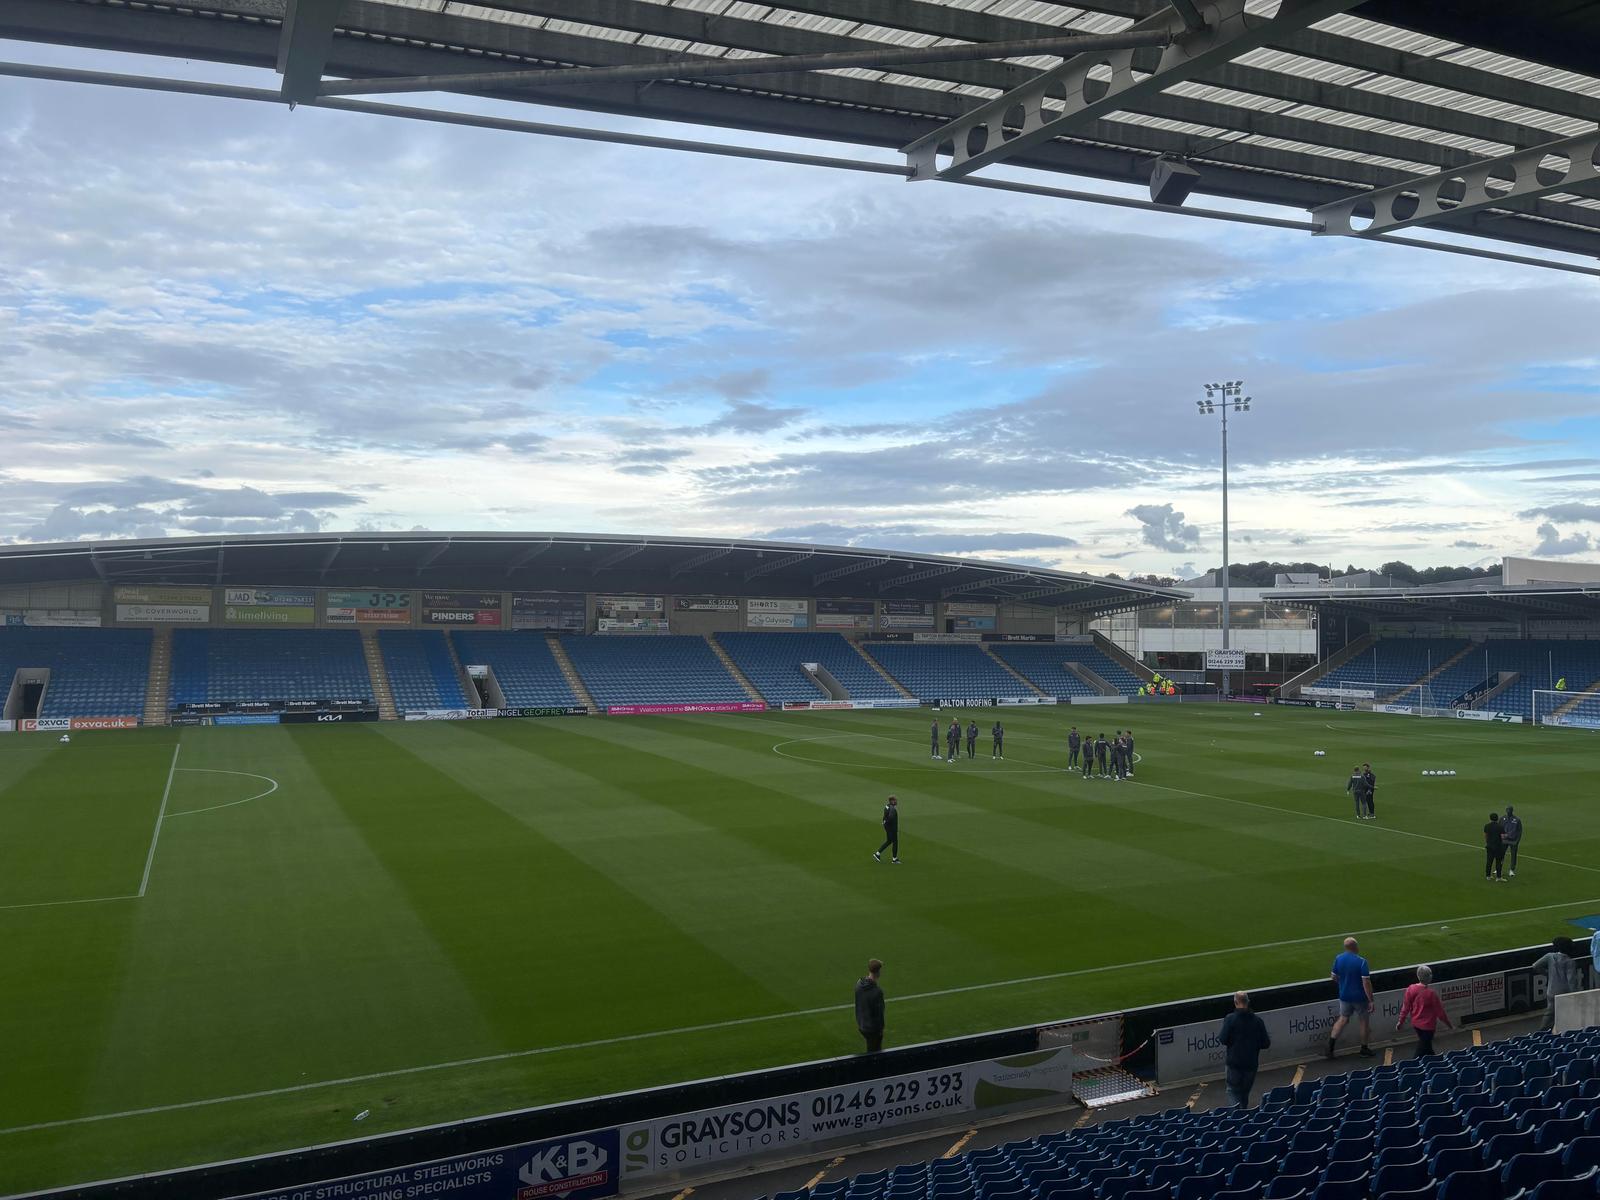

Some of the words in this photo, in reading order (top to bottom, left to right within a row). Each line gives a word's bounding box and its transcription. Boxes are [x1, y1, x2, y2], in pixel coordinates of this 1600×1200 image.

[431, 612, 475, 621] PINDERS
[764, 615, 793, 625] Odyssey
[939, 699, 964, 707] DALTON
[965, 698, 992, 707] ROOFING
[467, 709, 488, 717] Total
[498, 709, 522, 717] NIGEL
[524, 708, 566, 716] GEOFFREY
[38, 719, 69, 727] exvac
[74, 718, 125, 729] exvac.uk
[811, 1087, 876, 1118] 01246
[884, 1079, 920, 1105] 229
[927, 1071, 963, 1097] 393
[812, 1093, 963, 1133] www.graysons.co.uk
[660, 1101, 801, 1148] GRAYSONS
[659, 1127, 800, 1166] SOLICITORS
[292, 1190, 313, 1200] OF
[316, 1172, 410, 1200] STRUCTURAL
[414, 1153, 505, 1181] STEELWORKS
[406, 1171, 493, 1198] SPECIALISTS
[523, 1185, 548, 1199] ROUSE
[548, 1174, 603, 1192] CONSTRUCTION
